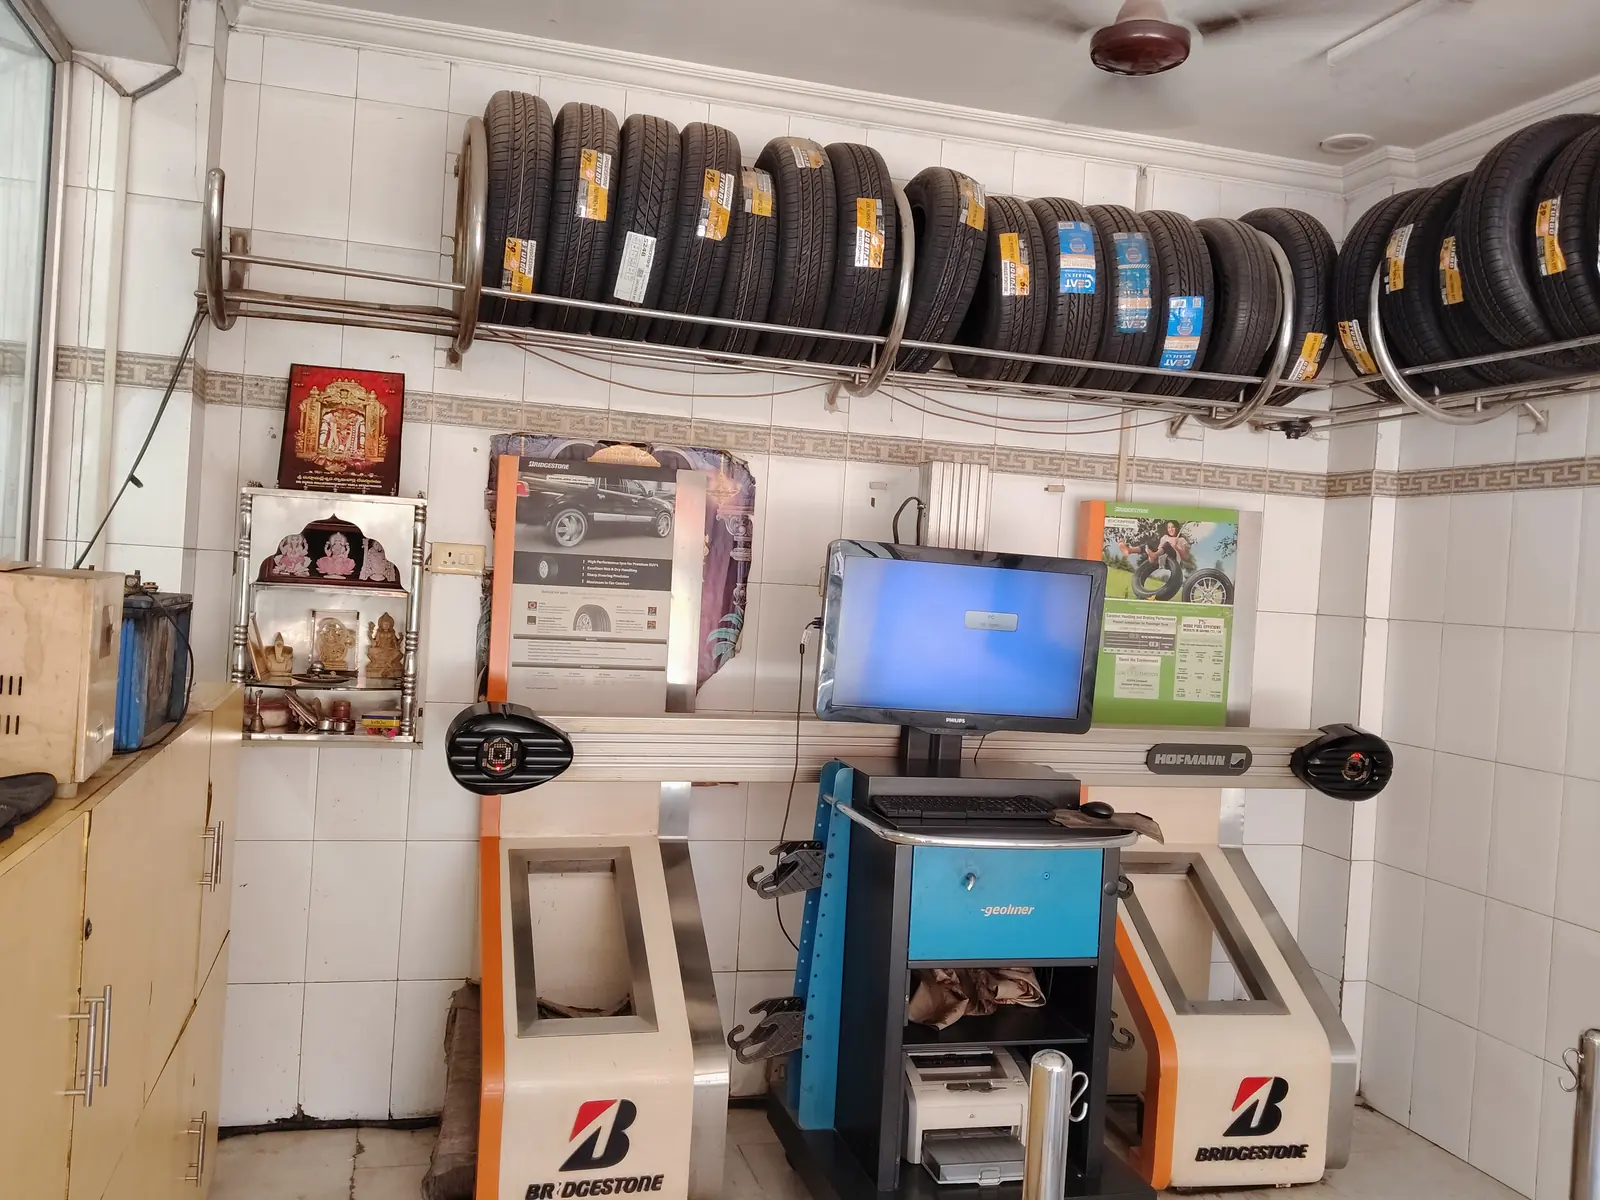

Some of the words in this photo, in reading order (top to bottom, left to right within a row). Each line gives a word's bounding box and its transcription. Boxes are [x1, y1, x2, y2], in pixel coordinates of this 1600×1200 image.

[583, 150, 592, 162] 29
[707, 170, 715, 183] 29
[1539, 203, 1547, 216] 29
[1549, 199, 1557, 235] STURDO
[507, 239, 516, 253] 29
[519, 240, 527, 273] STURDO
[1064, 278, 1091, 288] CEAT
[1120, 320, 1147, 329] CEAT
[1339, 324, 1347, 334] 29
[528, 461, 569, 470] BRIDGESTONE
[1154, 753, 1225, 766] HOFMANN
[1195, 1144, 1309, 1161] BRIDGESTONE
[525, 1174, 664, 1200] BRDGESTONE
